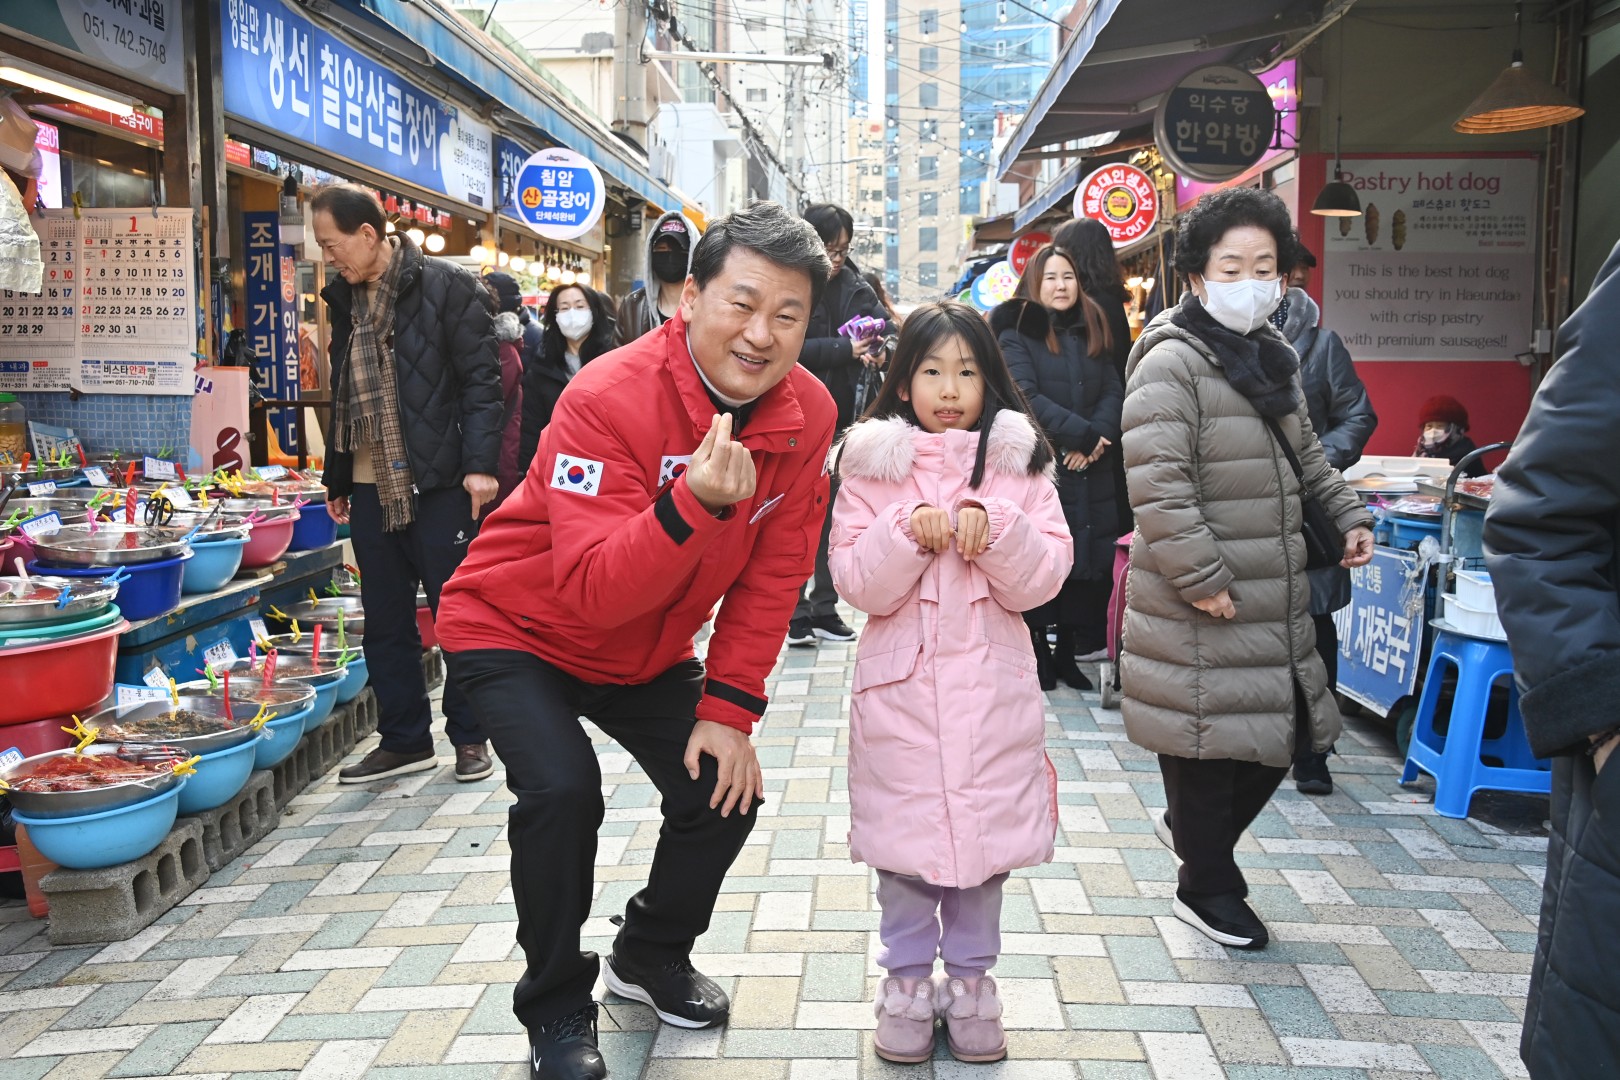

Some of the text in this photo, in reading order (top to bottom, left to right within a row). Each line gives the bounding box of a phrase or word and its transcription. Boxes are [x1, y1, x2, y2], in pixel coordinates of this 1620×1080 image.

[263, 12, 310, 118] 생선
[320, 44, 437, 171] 칠암산곰장어
[1188, 94, 1251, 115] 익수당
[1176, 119, 1261, 157] 한약방
[541, 169, 575, 188] 칠암
[1339, 171, 1500, 195] Pastry hot dog
[1460, 198, 1491, 212] 핫도그
[128, 216, 138, 232] 1
[535, 211, 576, 222] 단체석완비
[50, 252, 72, 261] 2 3
[101, 249, 181, 258] 1 2 3 4 5 6
[50, 270, 73, 280] 9 10
[85, 268, 184, 278] 7 8 9 10 11 12 13
[280, 256, 296, 303] 방
[1348, 264, 1510, 281] This is the best hot dog
[48, 288, 58, 298] 16
[63, 288, 72, 298] 17
[83, 287, 185, 297] 14 15 16 17 18 19 20
[1335, 287, 1521, 303] you should try in Haeundae
[3, 306, 73, 316] 20 21 22 23 24
[82, 306, 186, 316] 21 22 23 24 25 26 27
[1370, 310, 1484, 326] with crisp pastry
[2, 325, 44, 334] 27 28 29
[93, 324, 106, 334] 29
[108, 325, 121, 334] 30
[125, 325, 137, 334] 31
[1343, 333, 1508, 350] with premium sausages!!
[103, 365, 146, 376] 비스타안과
[1366, 564, 1382, 594] 전통
[1354, 604, 1411, 684] 재첩국
